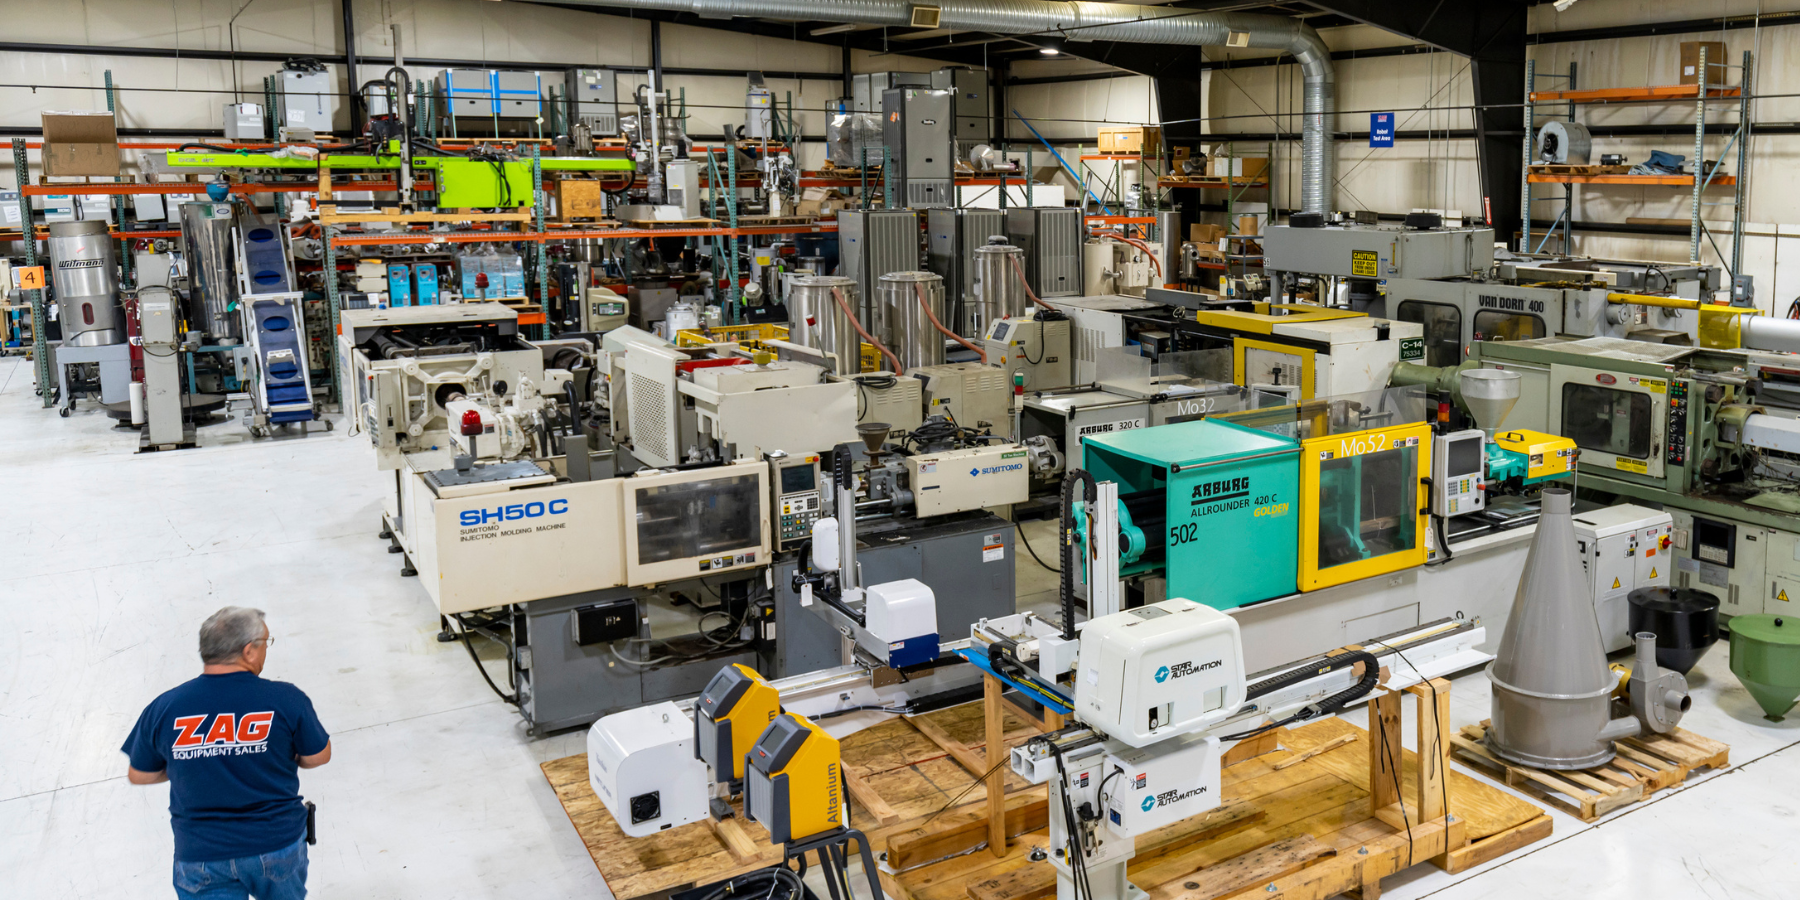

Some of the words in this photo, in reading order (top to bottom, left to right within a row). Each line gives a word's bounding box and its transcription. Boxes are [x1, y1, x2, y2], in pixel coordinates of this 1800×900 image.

[59, 258, 104, 269] Wittmann
[1353, 252, 1377, 260] CAUTION
[25, 272, 36, 284] 4
[1478, 294, 1498, 308] VAN
[1499, 297, 1524, 311] DORN
[1528, 300, 1544, 313] 400
[1402, 340, 1423, 350] C-14
[1177, 398, 1215, 416] Mo32
[1079, 423, 1113, 435] ARBURG
[1119, 421, 1132, 431] 320
[1134, 420, 1140, 428] C
[1341, 434, 1386, 458] Mo52
[982, 463, 1023, 475] SUMITOMO
[1191, 476, 1249, 499] ARBURG
[459, 501, 545, 526] SH50
[548, 498, 569, 515] C
[1190, 498, 1250, 518] ALLROUNDER
[1254, 495, 1270, 506] 420
[1271, 493, 1278, 503] C
[1253, 502, 1290, 517] GOLDEN
[460, 524, 500, 535] SUMITOMO
[460, 532, 497, 542] INJECTION
[500, 527, 533, 537] MOLDING
[536, 522, 567, 532] MACHINE
[1170, 522, 1198, 547] 502
[1170, 660, 1192, 673] STAR
[1170, 659, 1222, 680] AUTOMATION
[172, 710, 275, 749] ZAG
[173, 747, 233, 760] EQUIPMENT
[235, 744, 268, 756] SALES
[826, 762, 838, 823] Altanium
[1156, 788, 1178, 801] STAR
[1156, 785, 1207, 808] AUTOMATION
